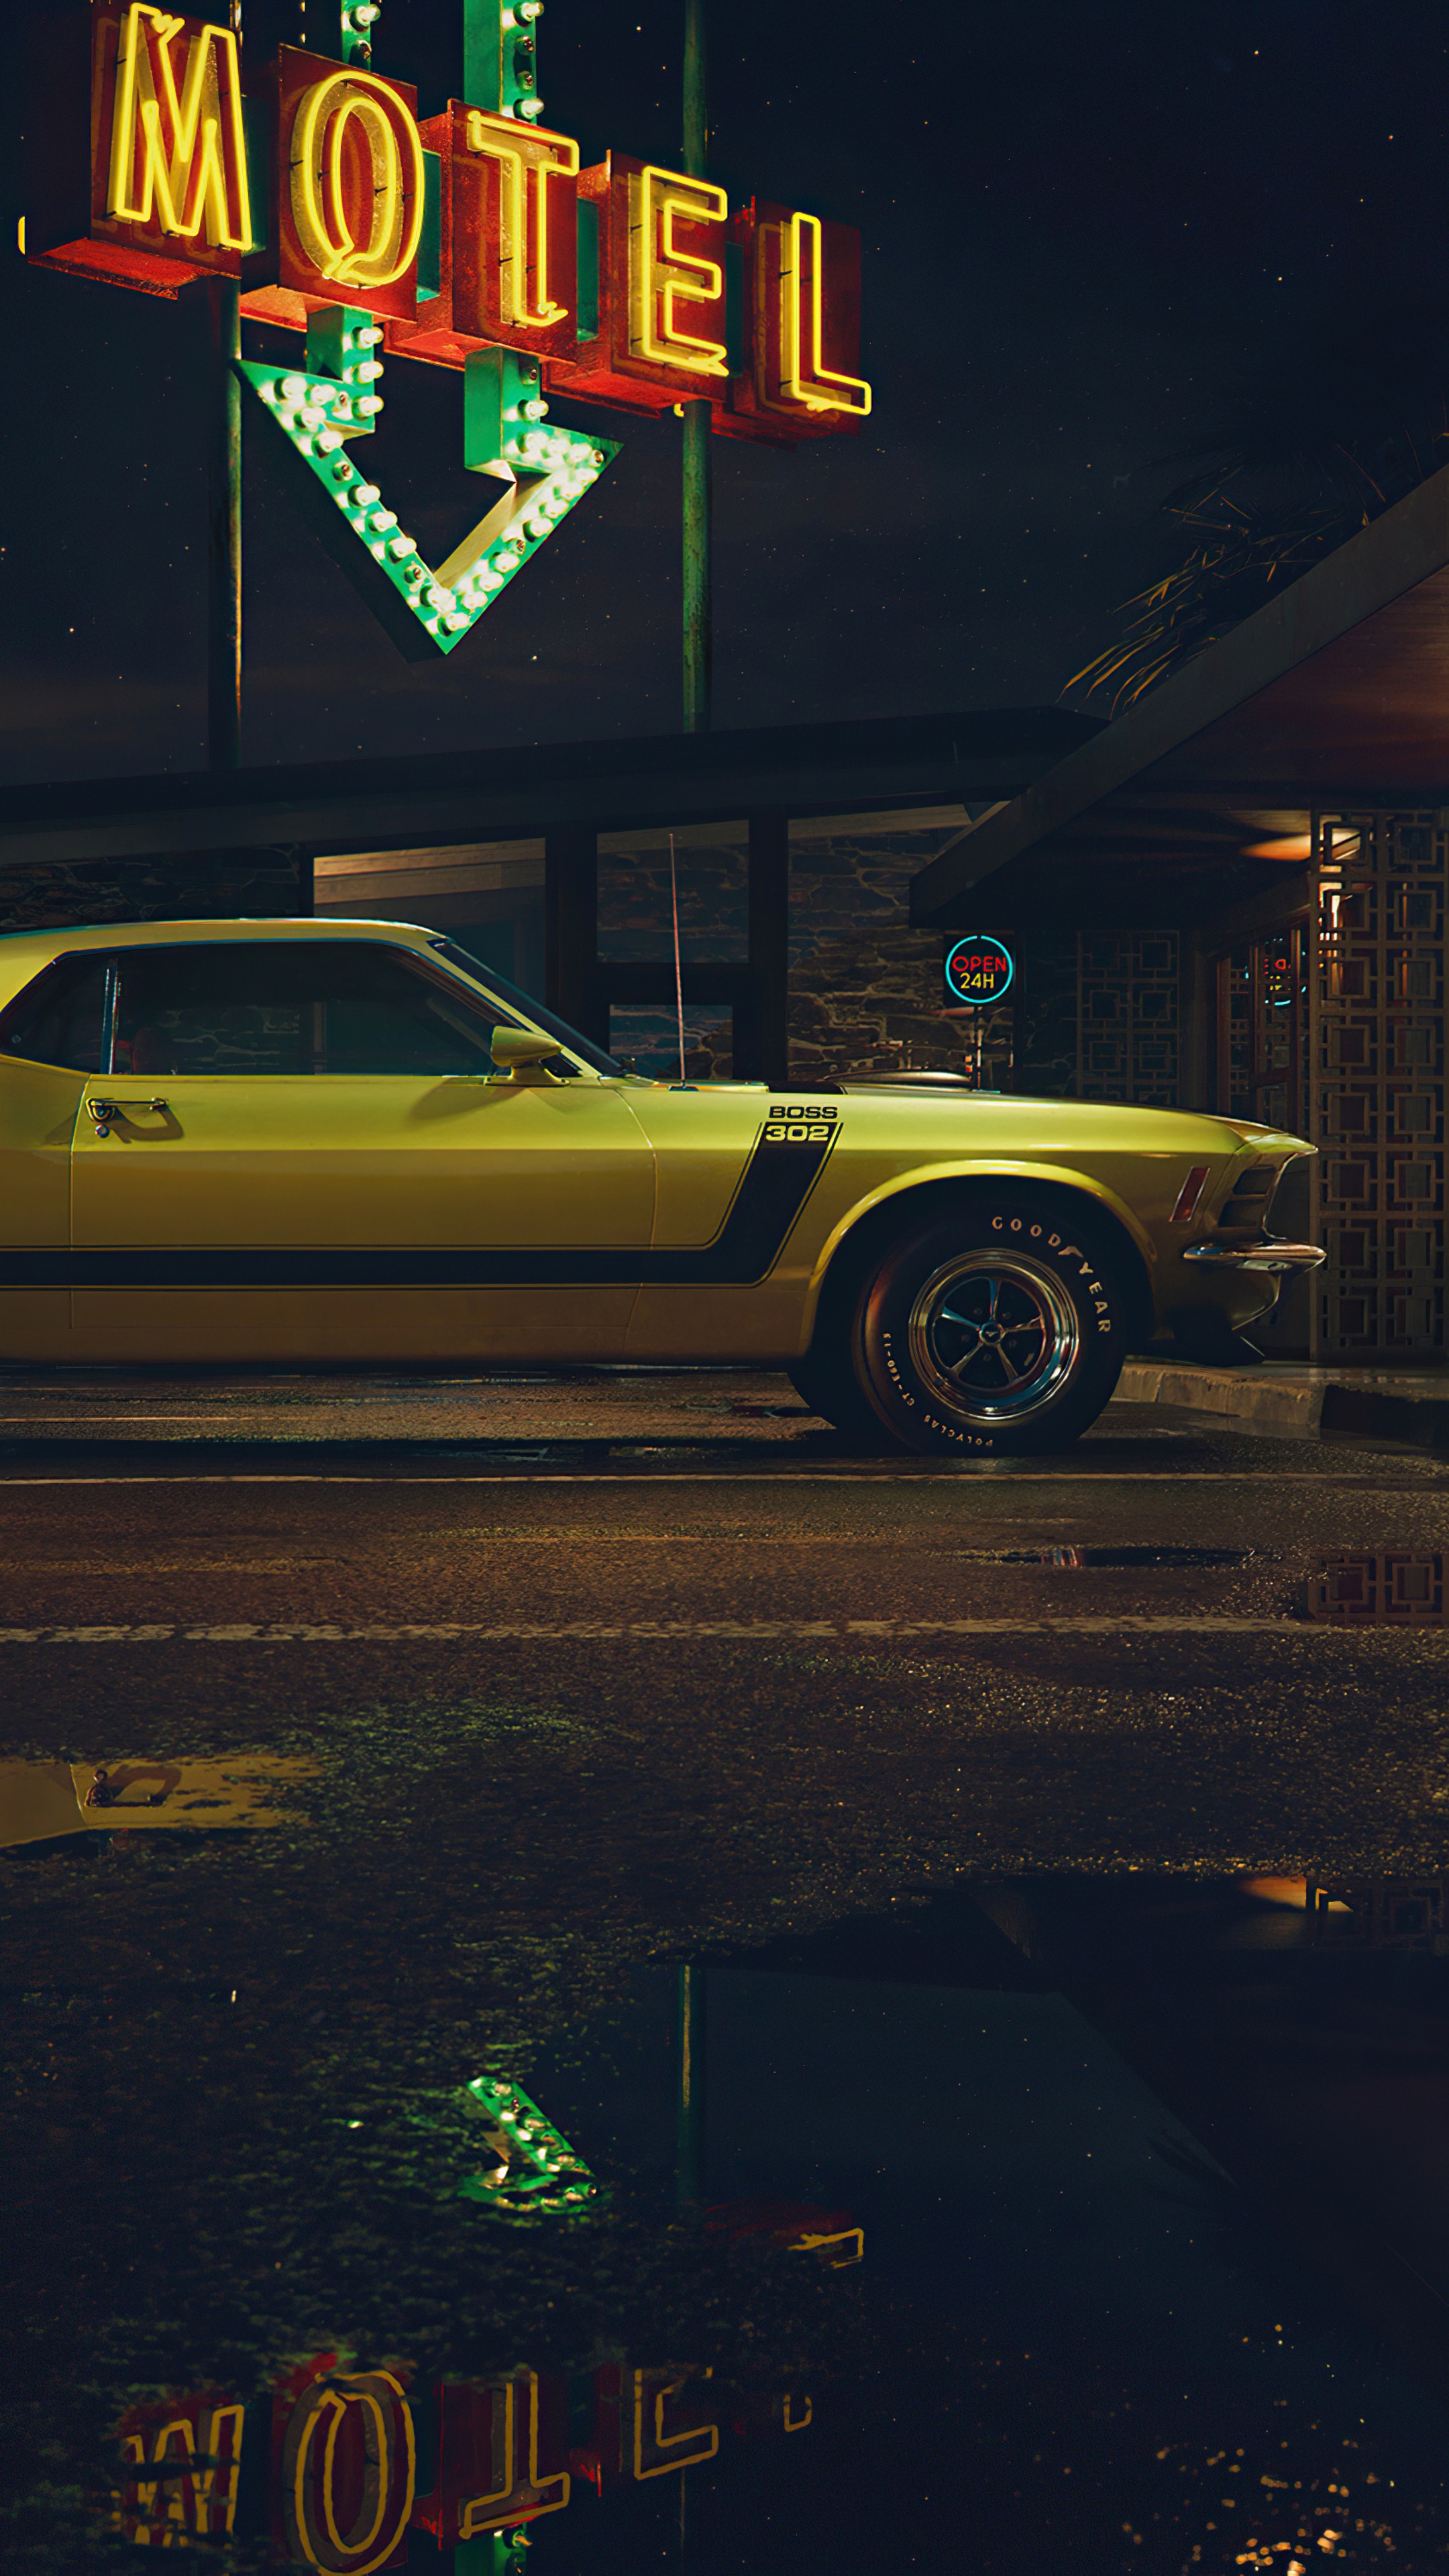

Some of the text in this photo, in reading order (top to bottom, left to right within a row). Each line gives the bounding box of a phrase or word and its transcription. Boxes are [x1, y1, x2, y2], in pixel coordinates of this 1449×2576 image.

[107, 2, 871, 415] MOTEL
[953, 956, 1006, 972] OPEN
[960, 972, 994, 989] 24H
[769, 1106, 837, 1119] BOSS
[765, 1125, 829, 1141] 302
[991, 1216, 1111, 1332] GOODYEAR
